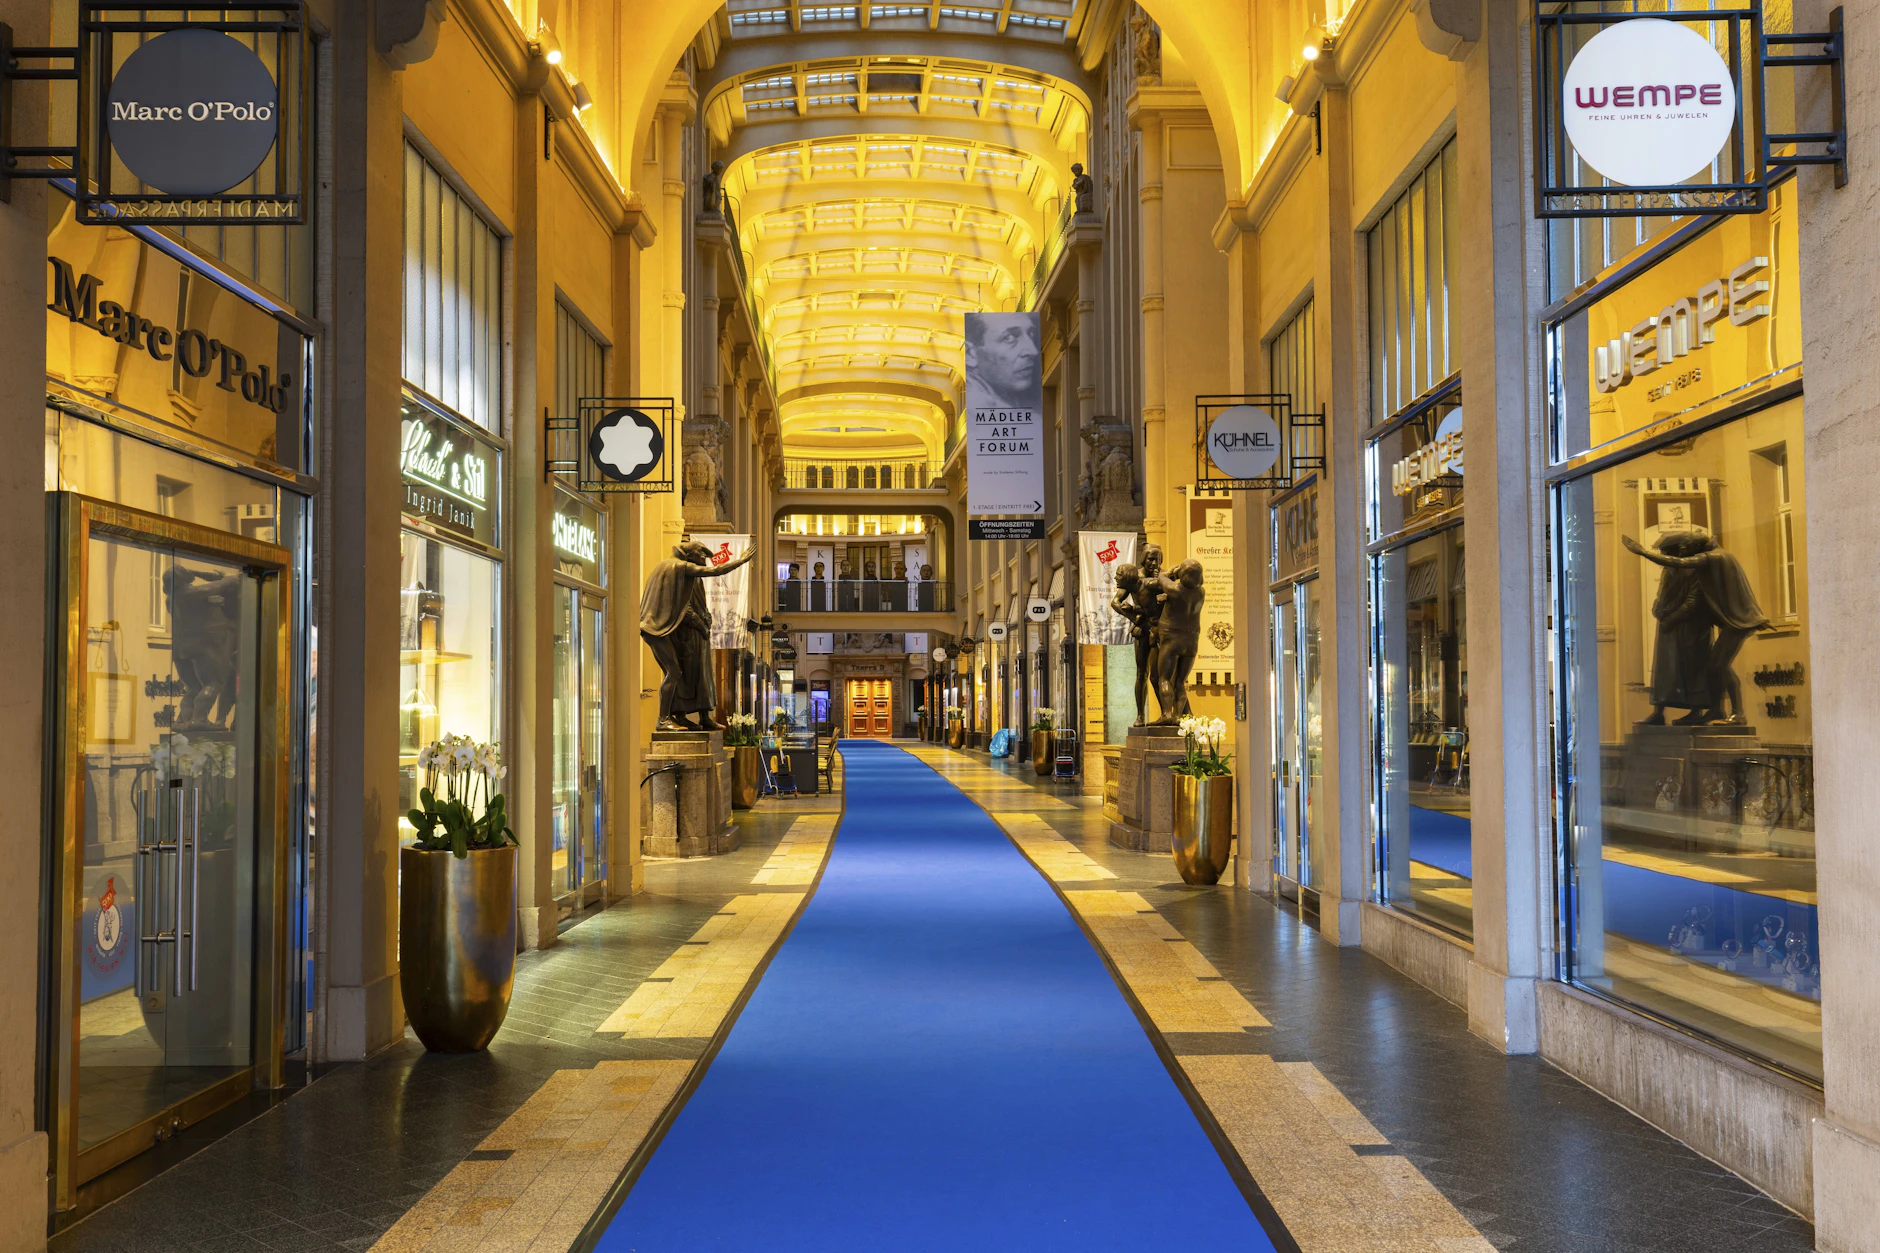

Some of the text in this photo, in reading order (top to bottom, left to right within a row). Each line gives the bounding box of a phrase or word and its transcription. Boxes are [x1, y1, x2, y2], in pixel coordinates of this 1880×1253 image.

[1575, 83, 1722, 109] WEMPE
[111, 101, 183, 121] Marc
[47, 256, 173, 361] Marc
[1594, 256, 1770, 393] WEMPE
[1647, 368, 1702, 402] SEIT 1878
[975, 409, 1032, 422] MÄDLER
[991, 427, 1017, 437] ART
[979, 442, 1029, 453] FORUM
[1214, 432, 1275, 452] KÜHNEL
[451, 462, 462, 490] &
[464, 453, 486, 502] Stil
[407, 485, 475, 530] Ingrid Janik
[712, 552, 727, 565] 500
[817, 549, 825, 558] K
[1099, 549, 1114, 562] 500
[817, 636, 825, 645] T
[912, 636, 921, 645] T
